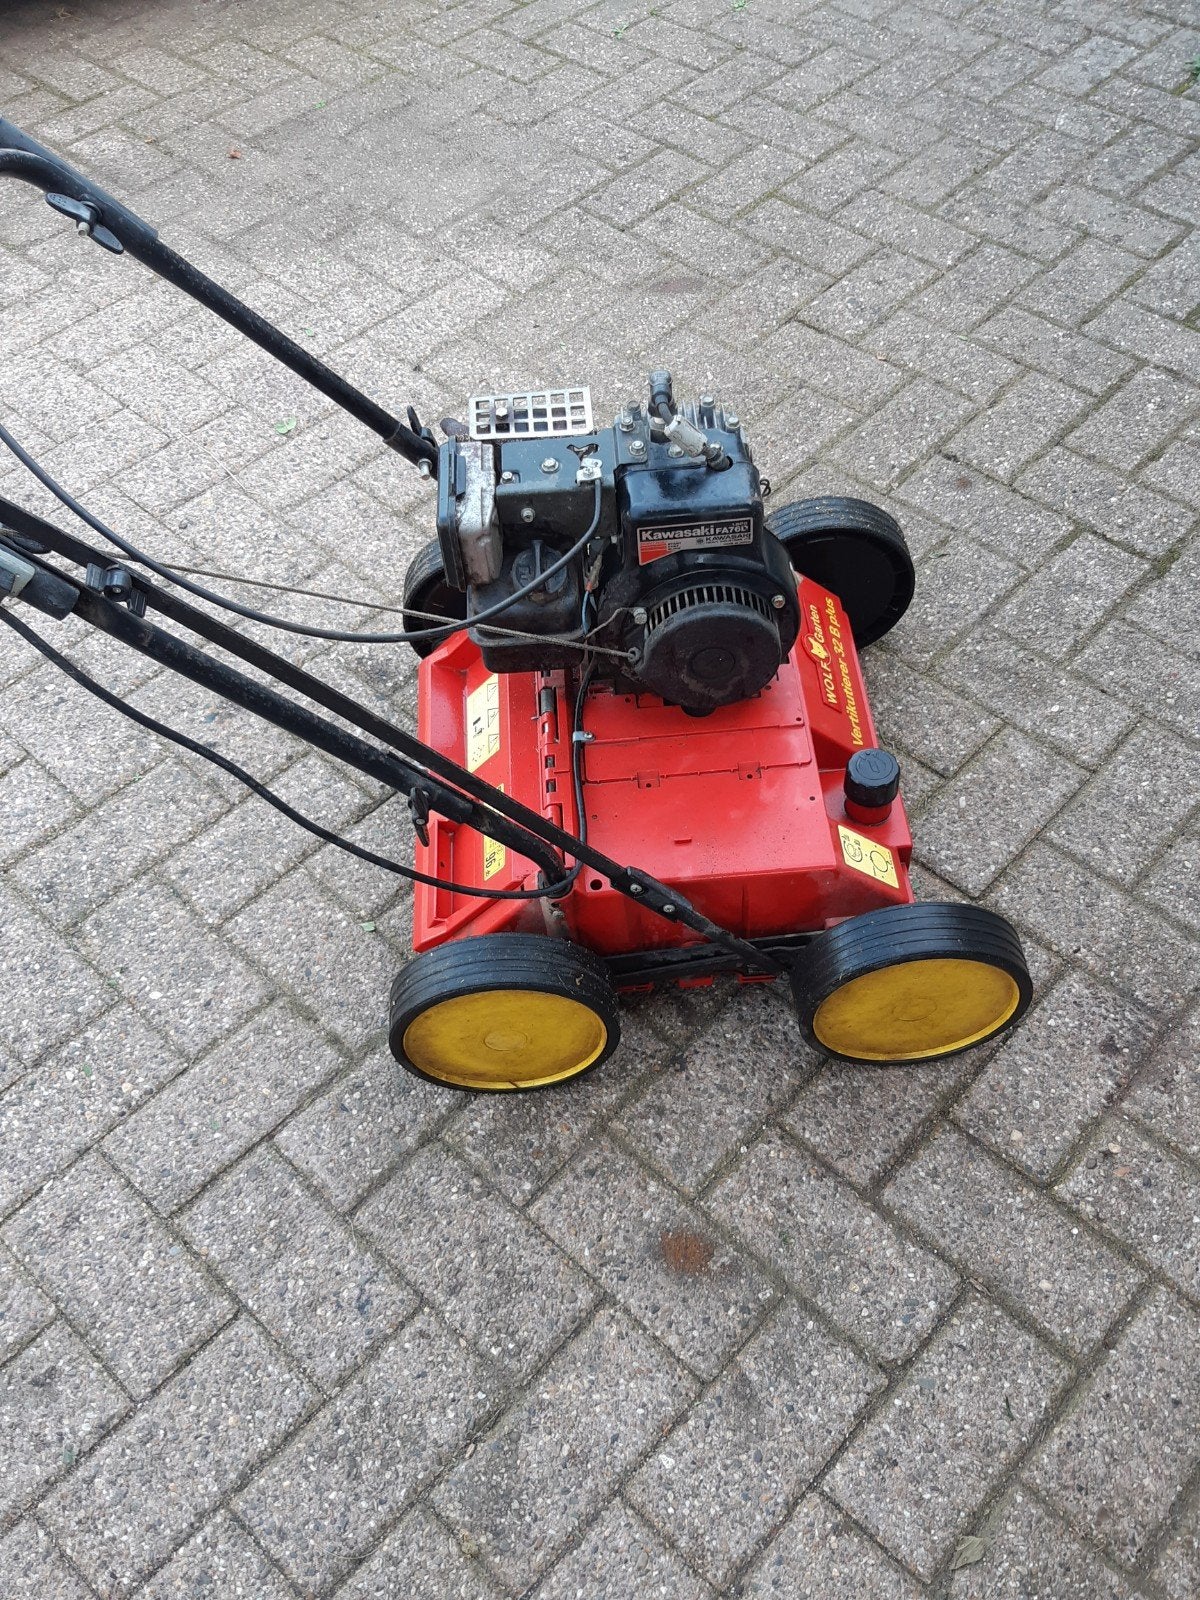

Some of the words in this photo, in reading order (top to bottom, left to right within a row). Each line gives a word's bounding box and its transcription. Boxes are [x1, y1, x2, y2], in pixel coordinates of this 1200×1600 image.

[641, 525, 715, 541] Kawasaki
[809, 604, 825, 644] Garten
[825, 597, 841, 628] plus
[829, 626, 841, 638] B
[832, 638, 845, 657] 32
[821, 660, 838, 704] WOLF
[838, 658, 864, 746] Vertikutierer
